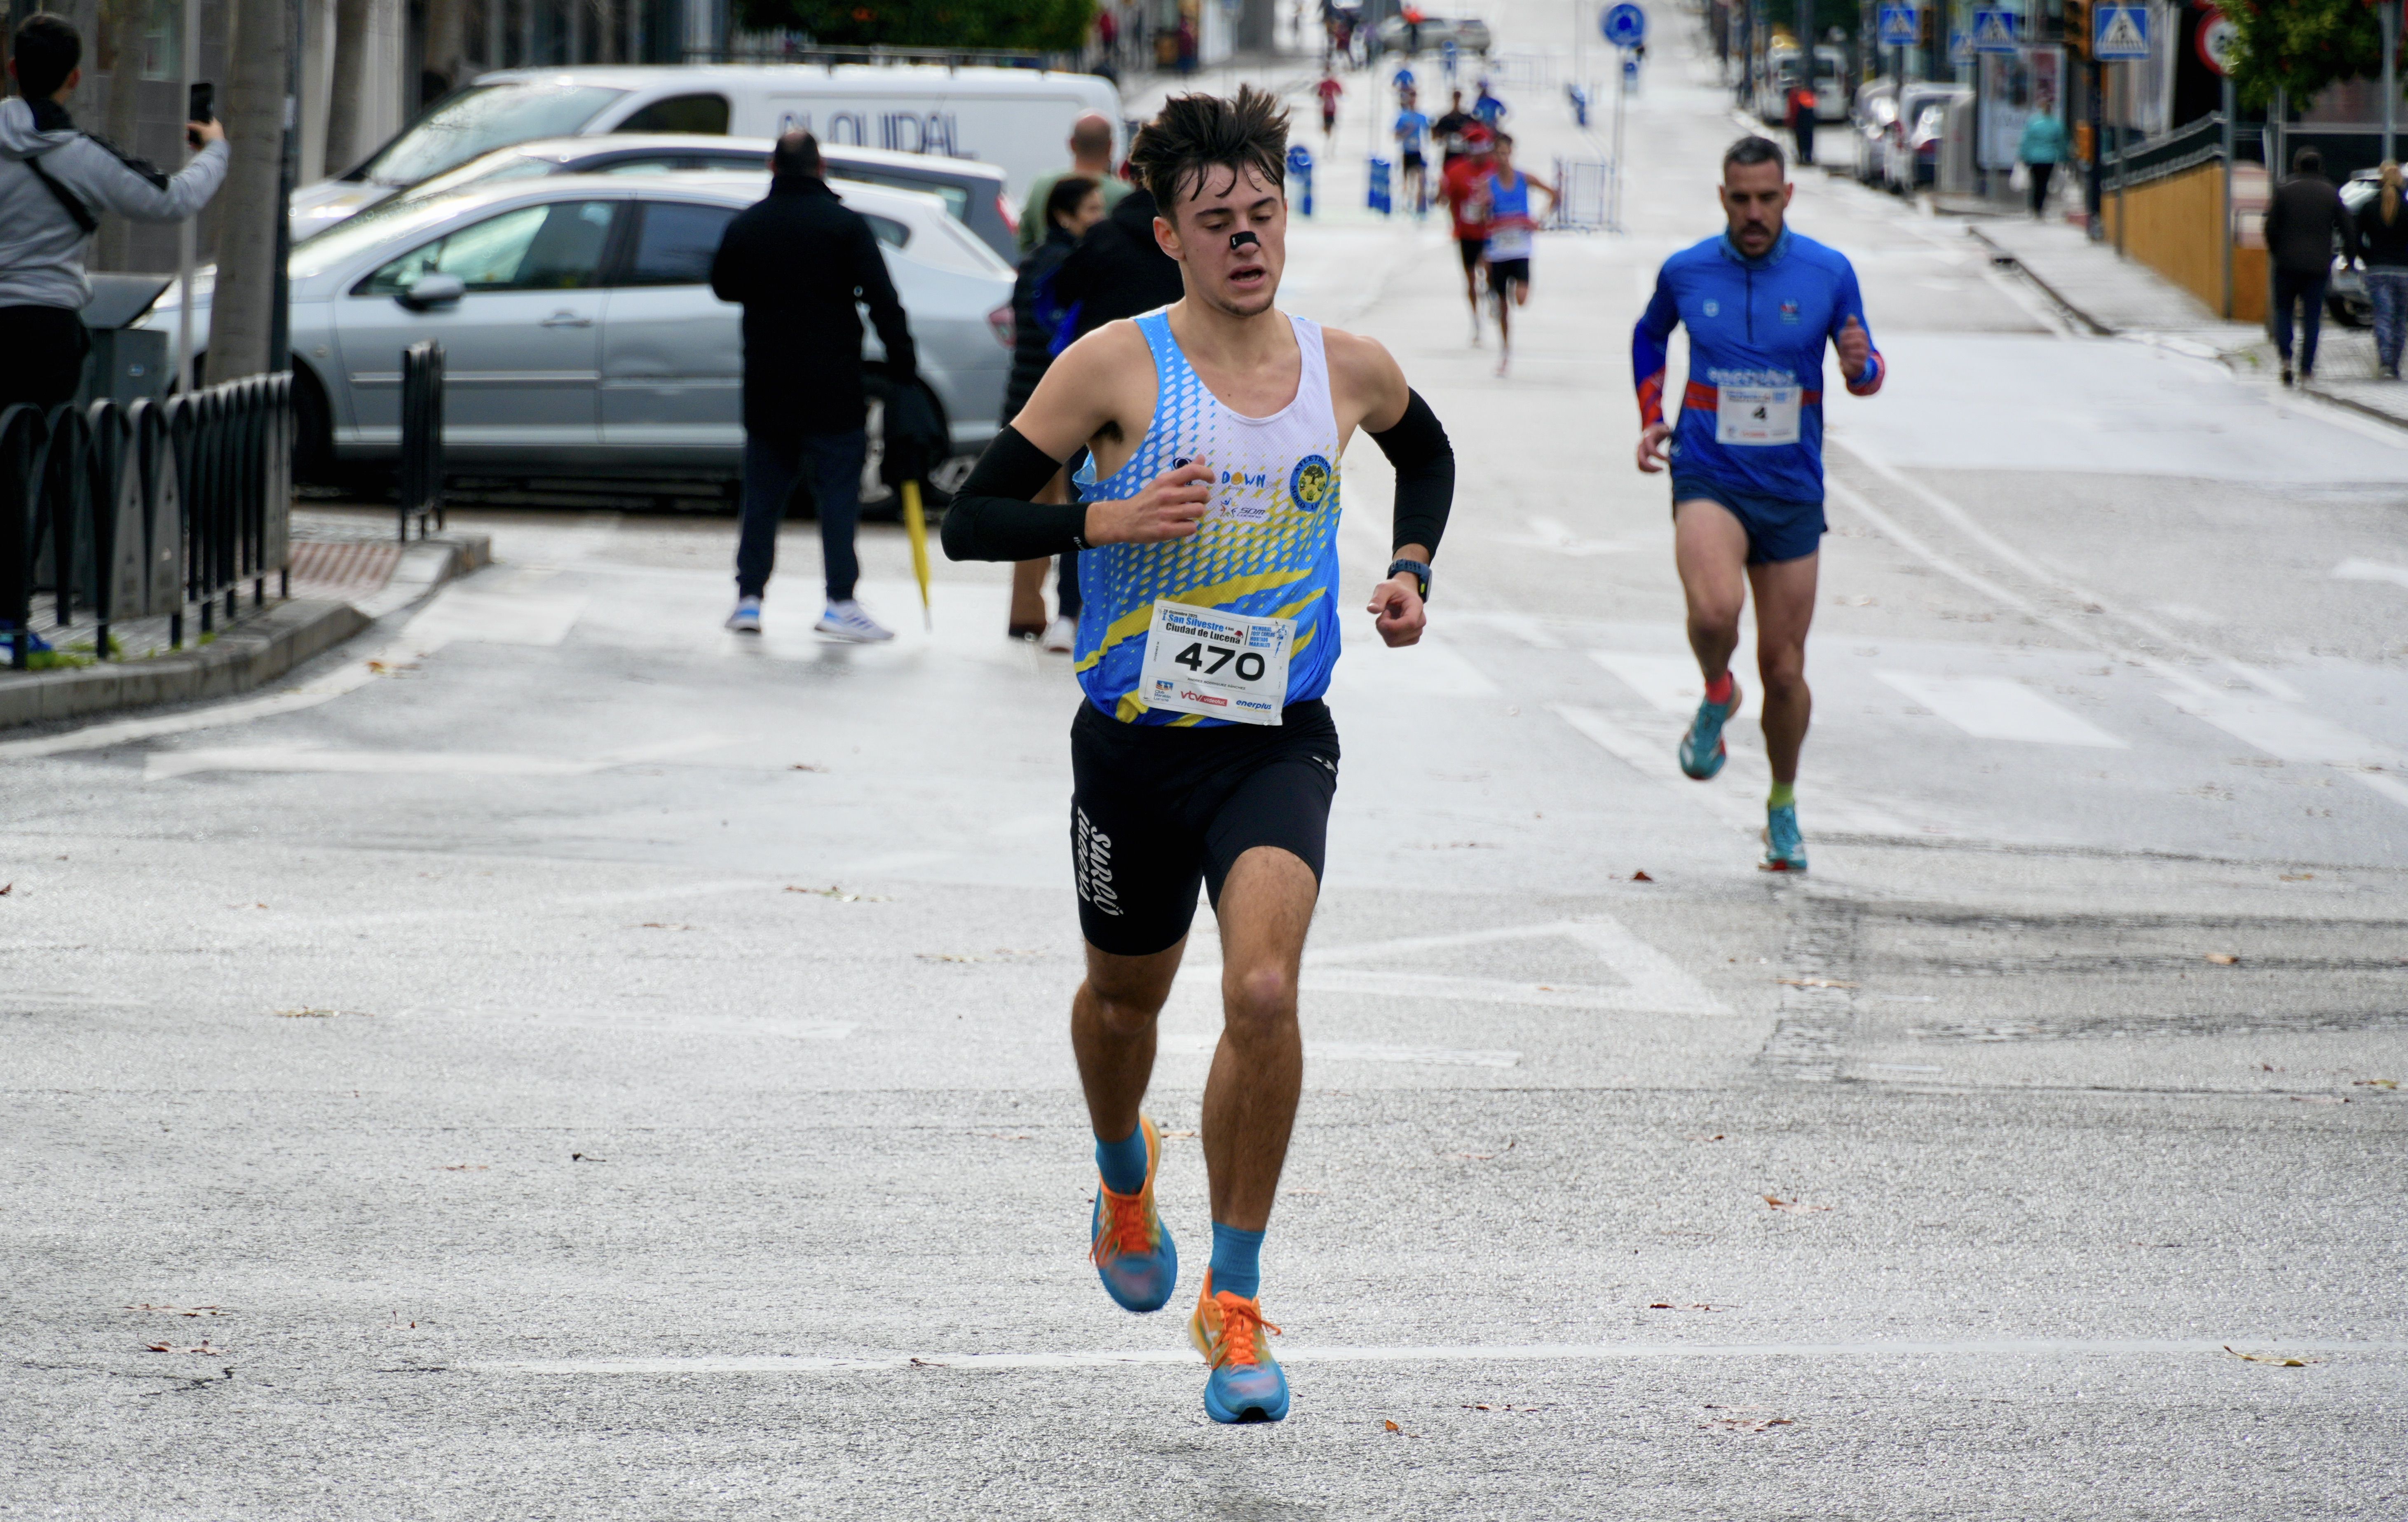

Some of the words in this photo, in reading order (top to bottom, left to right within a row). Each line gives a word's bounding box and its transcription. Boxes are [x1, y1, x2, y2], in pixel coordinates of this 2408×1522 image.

[1753, 406, 1766, 421] 4
[1222, 471, 1266, 488] DOWN
[1168, 614, 1184, 624] San
[1186, 617, 1224, 632] Silvestre
[1165, 623, 1196, 635] Ciudad
[1197, 629, 1208, 638] de
[1210, 631, 1240, 644] Lucena
[1175, 642, 1265, 681] 470
[1181, 690, 1203, 701] vtv
[1236, 700, 1272, 709] enerplus
[1077, 806, 1090, 901] LUCENA
[1090, 826, 1124, 916] SURCO
